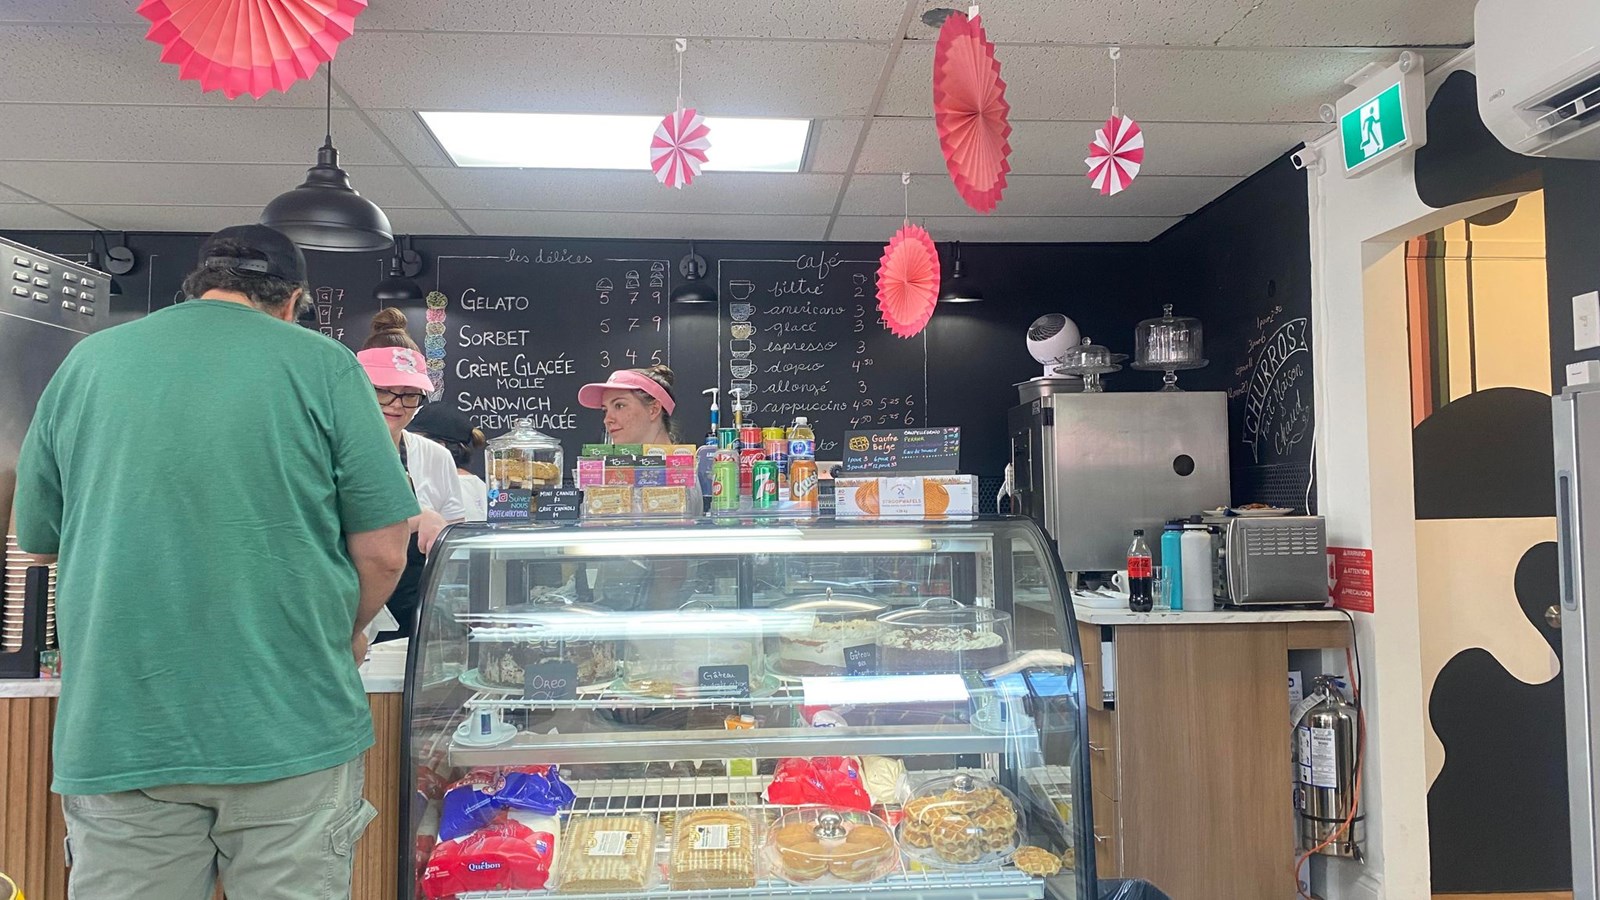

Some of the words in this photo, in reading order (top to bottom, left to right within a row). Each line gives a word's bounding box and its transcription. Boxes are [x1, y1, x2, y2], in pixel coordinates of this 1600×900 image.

[505, 248, 530, 264] les
[535, 248, 593, 264] délices
[336, 288, 345, 301] 7
[460, 288, 530, 312] GELATO
[600, 291, 610, 305] 5
[628, 291, 640, 304] 7
[652, 291, 662, 305] 9
[853, 286, 865, 298] 2
[336, 306, 345, 319] 7
[763, 301, 847, 316] americano
[853, 304, 866, 318] 3
[336, 328, 345, 340] 7
[459, 324, 530, 348] SORBET
[600, 318, 611, 333] 5
[628, 318, 640, 332] 7
[652, 316, 662, 332] 9
[853, 319, 865, 333] 3
[762, 341, 837, 356] espresso
[856, 340, 866, 354] 3
[455, 356, 511, 380] CRÈME
[514, 353, 576, 377] GLACÉE
[600, 351, 611, 368] 3
[625, 348, 638, 365] 4
[651, 349, 662, 366] 5
[497, 377, 546, 390] MOLLE
[1245, 324, 1297, 435] CHURROS
[762, 379, 830, 397] allongé
[858, 380, 868, 393] 3
[457, 392, 551, 412] SANDWICH
[761, 400, 848, 415] cappuccino
[905, 394, 915, 407] 6
[904, 410, 915, 426] 6
[871, 433, 899, 443] Gaufre
[872, 442, 896, 454] Belge
[702, 671, 736, 681] Gâteau
[467, 861, 501, 873] Québon
